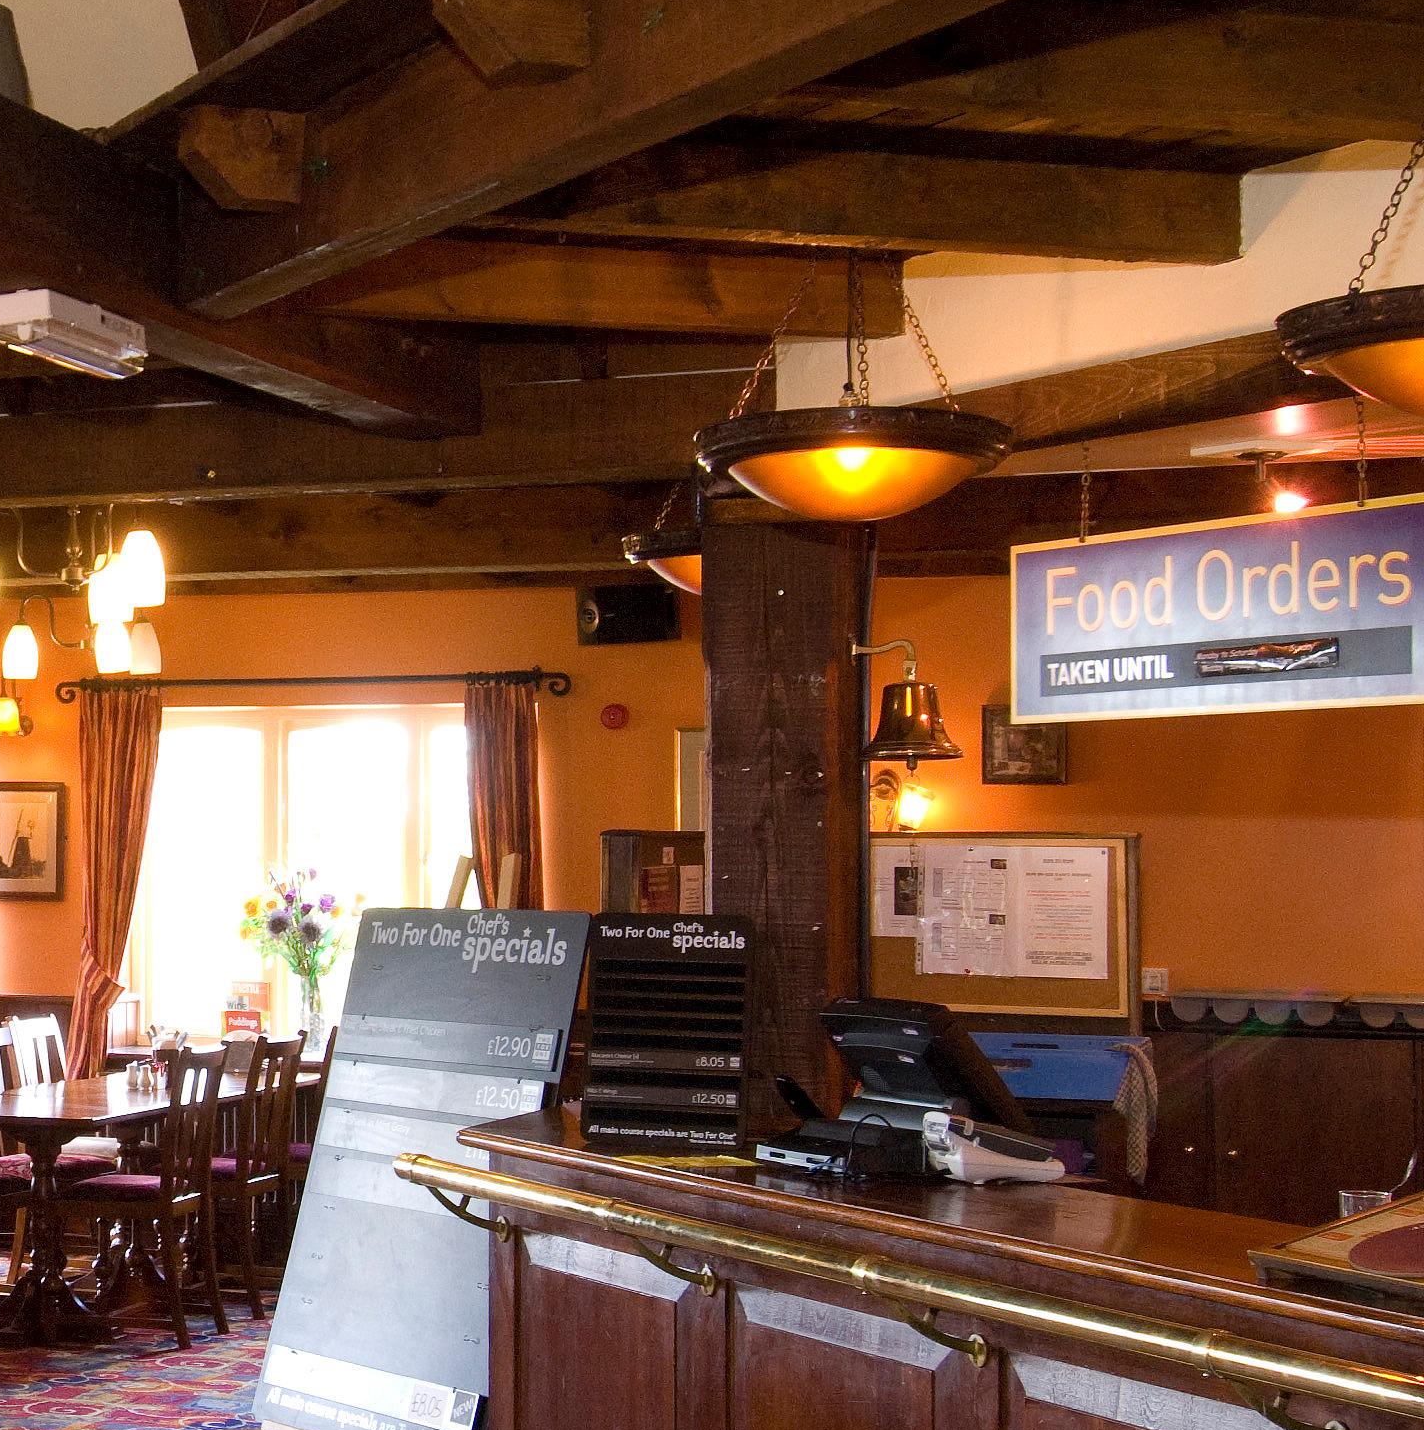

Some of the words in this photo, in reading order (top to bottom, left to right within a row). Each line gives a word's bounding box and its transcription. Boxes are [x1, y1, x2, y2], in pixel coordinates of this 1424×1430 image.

[1046, 555, 1173, 636] Food
[1196, 540, 1413, 621] Orders
[1046, 659, 1111, 687] TAKEN
[1113, 654, 1174, 683] UNTIL
[371, 921, 399, 945] Two
[401, 922, 428, 947] For
[430, 922, 462, 947] One
[467, 912, 511, 936] Chef's
[600, 925, 623, 938] Two
[625, 926, 645, 939] For
[646, 926, 671, 939] One
[673, 921, 705, 934] Chef's
[462, 928, 567, 973] specials
[672, 930, 746, 954] specials
[226, 1000, 248, 1011] Wine
[228, 1016, 259, 1030] Puddings
[487, 1035, 531, 1058] £12.90
[695, 1056, 725, 1068] £8.05
[475, 1085, 520, 1110] £12.50
[691, 1093, 725, 1105] £12.50
[588, 1124, 599, 1134] All
[599, 1125, 619, 1134] main
[620, 1127, 644, 1136] course
[645, 1128, 675, 1138] specials
[676, 1130, 689, 1138] are
[689, 1130, 704, 1139] Two
[705, 1131, 718, 1140] For
[265, 1386, 281, 1405] All
[279, 1393, 304, 1412] main
[304, 1401, 337, 1420] course
[336, 1409, 378, 1430] specials
[411, 1392, 443, 1418] £8.05
[453, 1396, 475, 1418] NEW!
